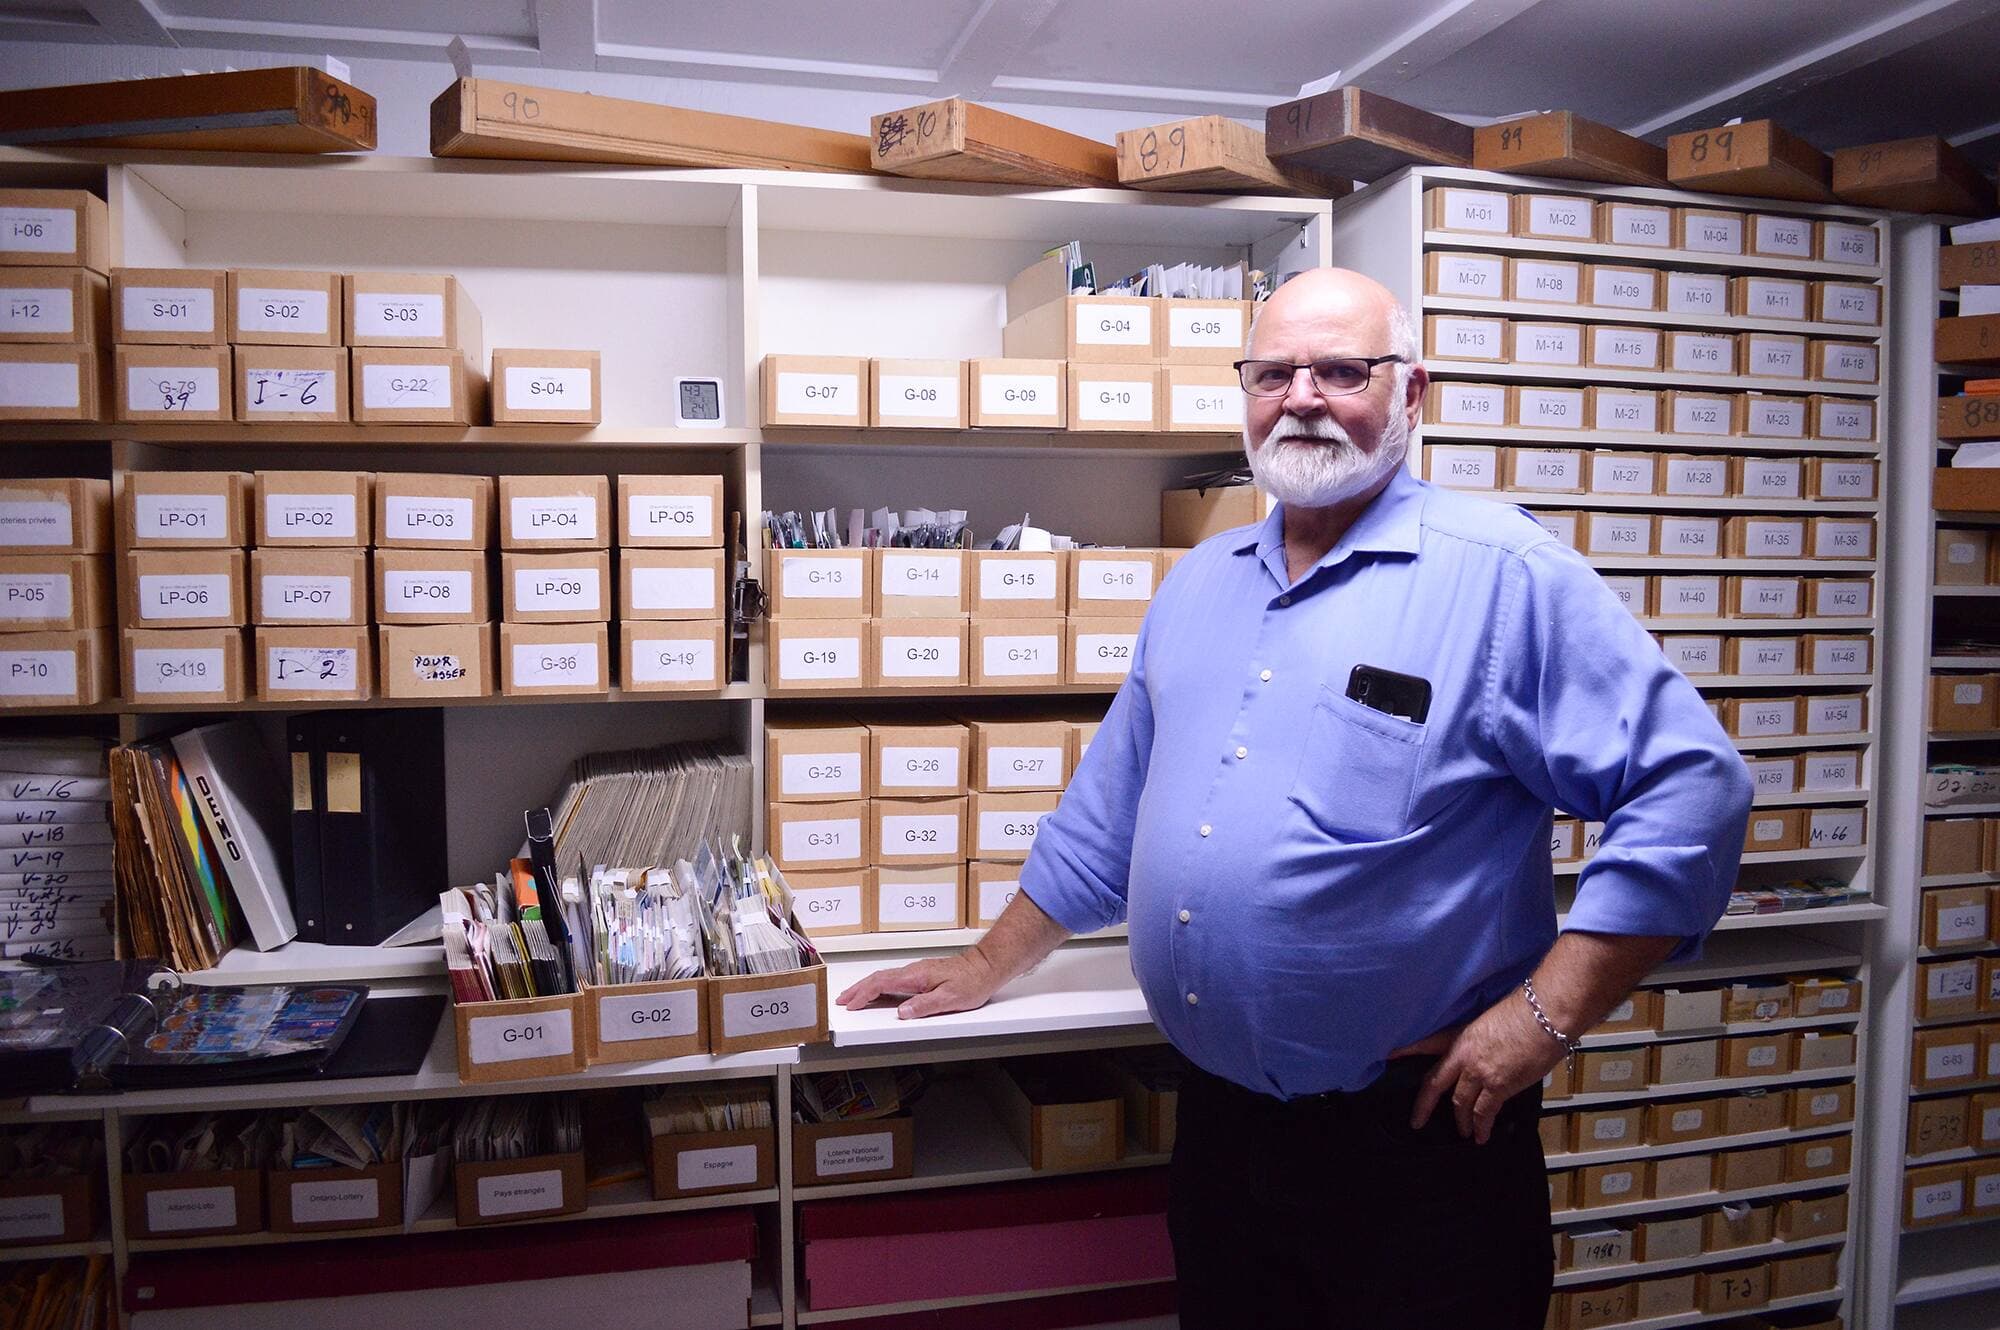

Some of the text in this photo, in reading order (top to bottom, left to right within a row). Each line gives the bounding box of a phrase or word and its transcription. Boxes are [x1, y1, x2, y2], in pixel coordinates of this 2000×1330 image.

[503, 93, 540, 119] 90
[1287, 100, 1311, 126] 91
[1501, 127, 1522, 151] 89
[1691, 131, 1733, 162] 89
[1466, 208, 1491, 220] M-01
[1550, 213, 1576, 225] M-02
[15, 224, 42, 237] i-06
[1631, 223, 1656, 235] M-03
[1704, 230, 1728, 242] M-04
[1775, 232, 1798, 245] M-05
[1460, 272, 1486, 284] M-07
[1537, 278, 1562, 290] M-08
[1614, 285, 1639, 297] M-09
[1687, 292, 1711, 303] M-10
[1767, 295, 1788, 306] M-11
[12, 305, 39, 317] i-12
[154, 304, 186, 317] S-01
[1840, 299, 1864, 311] M-12
[265, 305, 299, 318] S-02
[384, 309, 417, 321] S-03
[1101, 320, 1130, 331] G-04
[1191, 322, 1220, 334] G-05
[1457, 333, 1484, 345] M-13
[1536, 340, 1563, 351] M-14
[1615, 343, 1641, 355] M-15
[1768, 351, 1791, 364] M-17
[1841, 358, 1864, 369] M-18
[391, 379, 427, 393] G-22
[531, 382, 563, 394] S-04
[806, 386, 838, 398] G-07
[905, 388, 936, 400] G-08
[1005, 390, 1035, 401] G-09
[1100, 392, 1130, 403] G-10
[1196, 399, 1223, 410] G-11
[1462, 400, 1489, 412] M-19
[1540, 403, 1566, 415] M-20
[1615, 408, 1639, 419] M-21
[1692, 411, 1716, 422] M-22
[1767, 414, 1789, 425] M-23
[1837, 416, 1859, 426] M-24
[1452, 464, 1480, 475] M-25
[1537, 465, 1564, 476] M-26
[1613, 470, 1639, 481] M-27
[1687, 472, 1711, 483] M-28
[1763, 475, 1786, 486] M-29
[1838, 475, 1861, 485] M-30
[28, 516, 57, 527] privées
[1612, 531, 1636, 542] M-33
[1680, 533, 1704, 544] M-34
[1765, 535, 1789, 545] M-35
[809, 571, 841, 583] G-13
[907, 568, 939, 580] G-14
[1004, 574, 1034, 585] G-15
[1103, 573, 1133, 584] G-16
[9, 588, 44, 601] P-05
[1680, 592, 1705, 602] M-40
[1760, 592, 1782, 602] M-41
[1834, 594, 1856, 604] M-42
[804, 652, 836, 663] G-19
[907, 648, 938, 660] G-20
[1008, 649, 1037, 660] G-21
[1098, 646, 1128, 657] G-22
[1682, 651, 1706, 661] M-46
[1832, 652, 1855, 662] M-48
[542, 657, 576, 670] G-36
[660, 653, 694, 666] G-19
[1759, 653, 1782, 664] M-47
[12, 664, 47, 677] P-10
[161, 662, 206, 676] G-119
[1757, 714, 1781, 725] M-53
[1826, 710, 1847, 720] M-54
[907, 760, 939, 771] G-26
[1013, 760, 1043, 771] G-27
[809, 766, 841, 778] G-25
[1759, 771, 1782, 784] M-59
[1823, 768, 1845, 778] M-60
[906, 830, 936, 841] G-32
[1004, 823, 1034, 836] G-33
[808, 833, 839, 845] G-31
[809, 900, 840, 912] G-37
[904, 896, 935, 907] G-38
[751, 1001, 789, 1017] G-03
[632, 1009, 670, 1023] G-02
[504, 1026, 542, 1042] G-01
[828, 1146, 879, 1158] Loterie National
[856, 1152, 885, 1164] Belgique
[704, 1160, 734, 1170] Espagne
[494, 1189, 513, 1199] Pays
